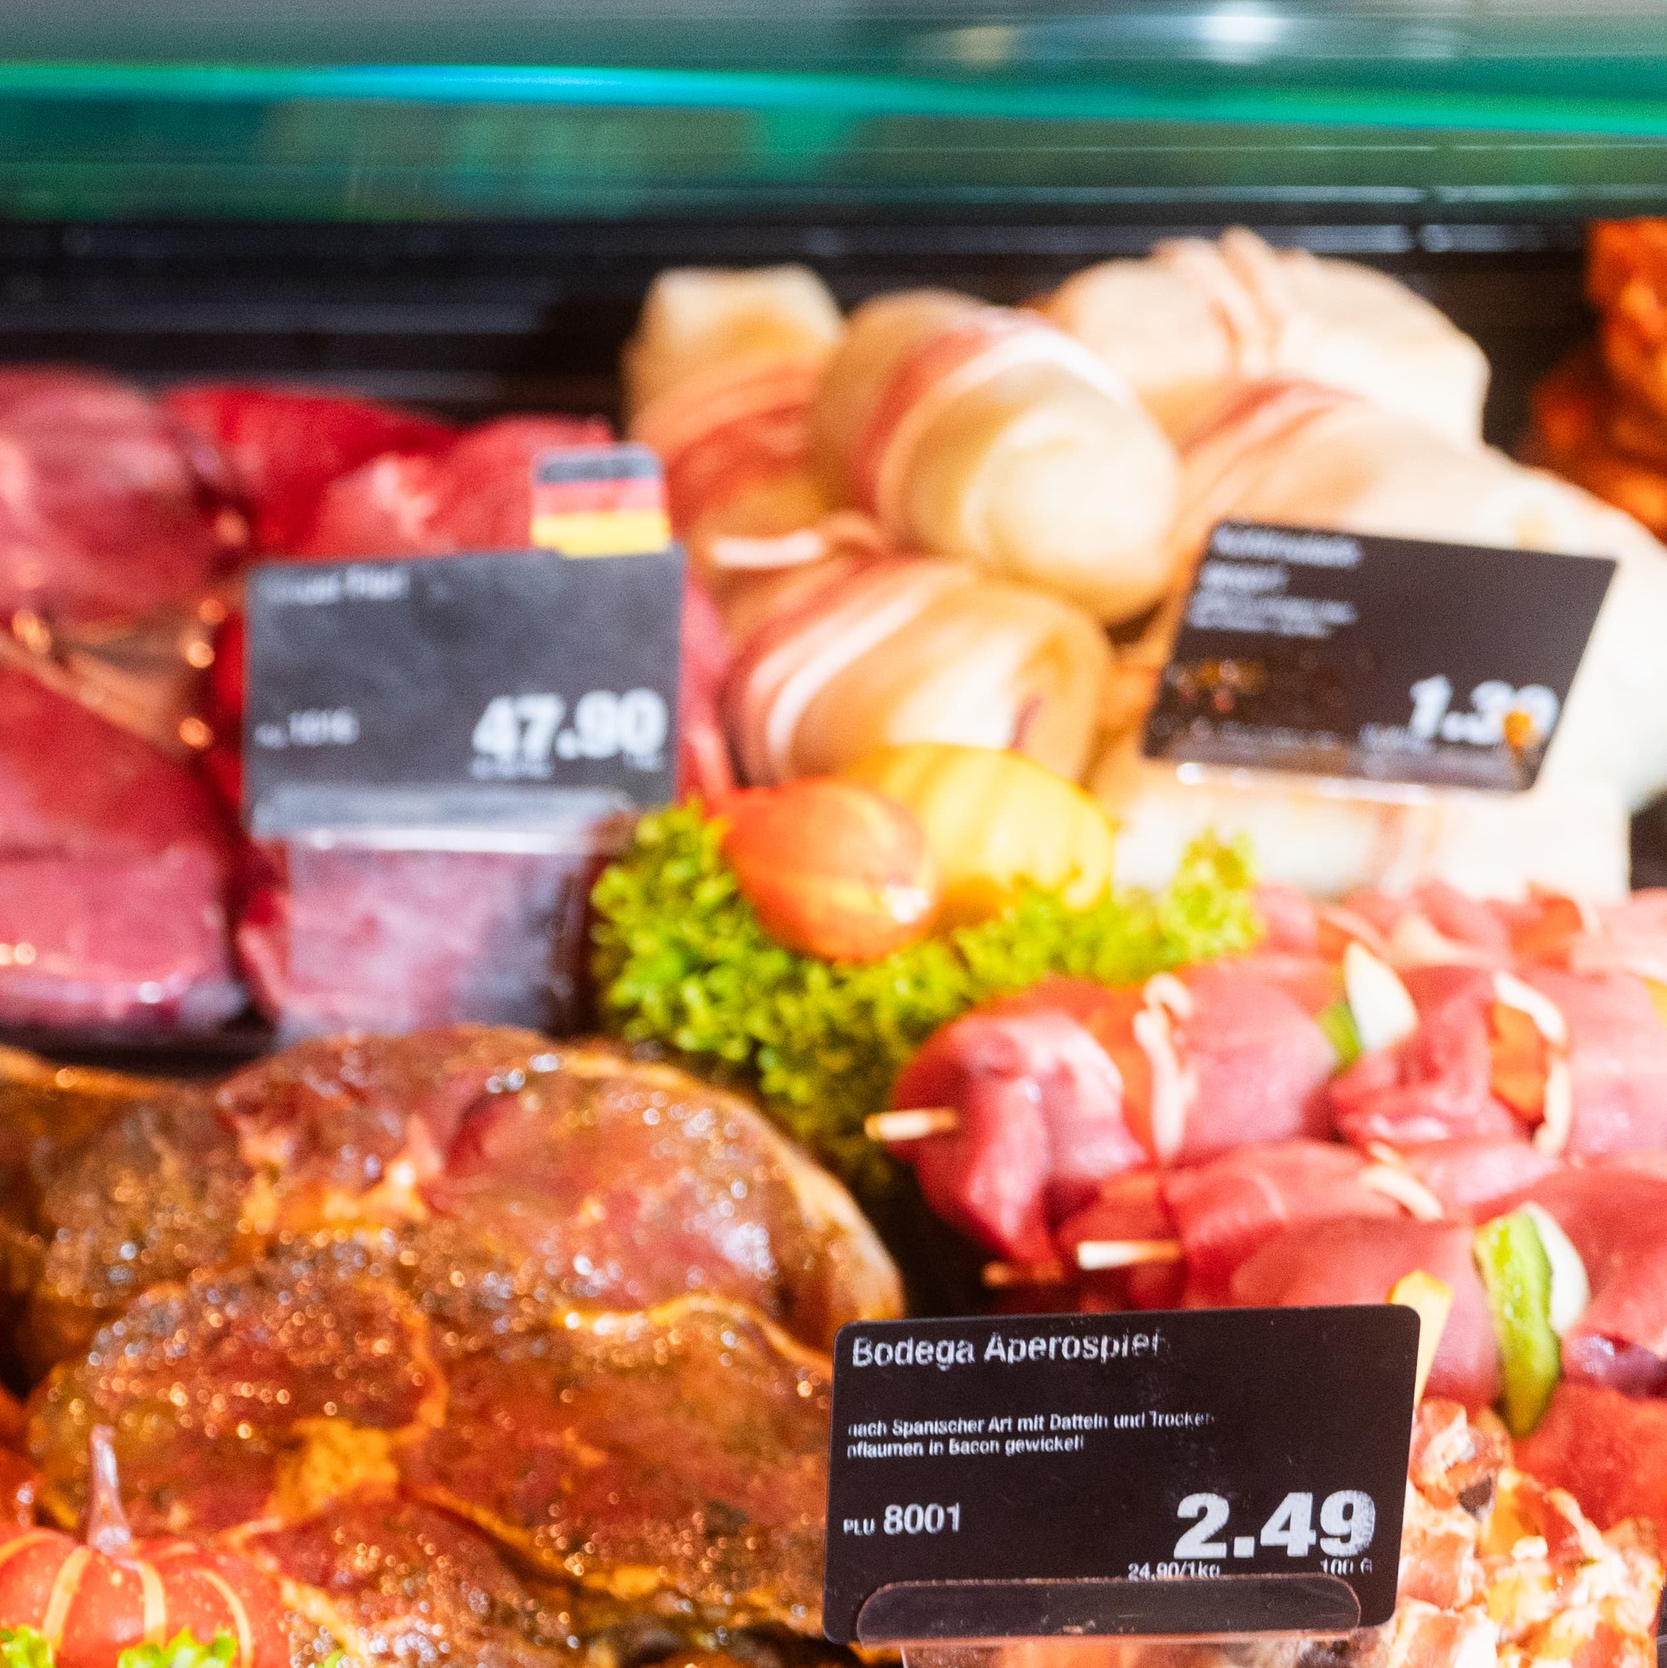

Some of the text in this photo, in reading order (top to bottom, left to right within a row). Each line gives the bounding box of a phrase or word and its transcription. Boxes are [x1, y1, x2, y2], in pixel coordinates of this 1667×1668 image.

[473, 688, 667, 760] 47.90
[852, 1336, 974, 1371] Bodega
[848, 1419, 887, 1437] nach
[892, 1417, 984, 1439] Spanischer
[987, 1415, 1013, 1434] Art
[1018, 1414, 1045, 1432] mit
[1050, 1411, 1108, 1431] Datteln
[1114, 1411, 1146, 1430] und
[929, 1436, 943, 1455] in
[949, 1434, 1000, 1454] Bacon
[843, 1502, 961, 1536] PLU 8001
[1173, 1490, 1376, 1559] 2.49
